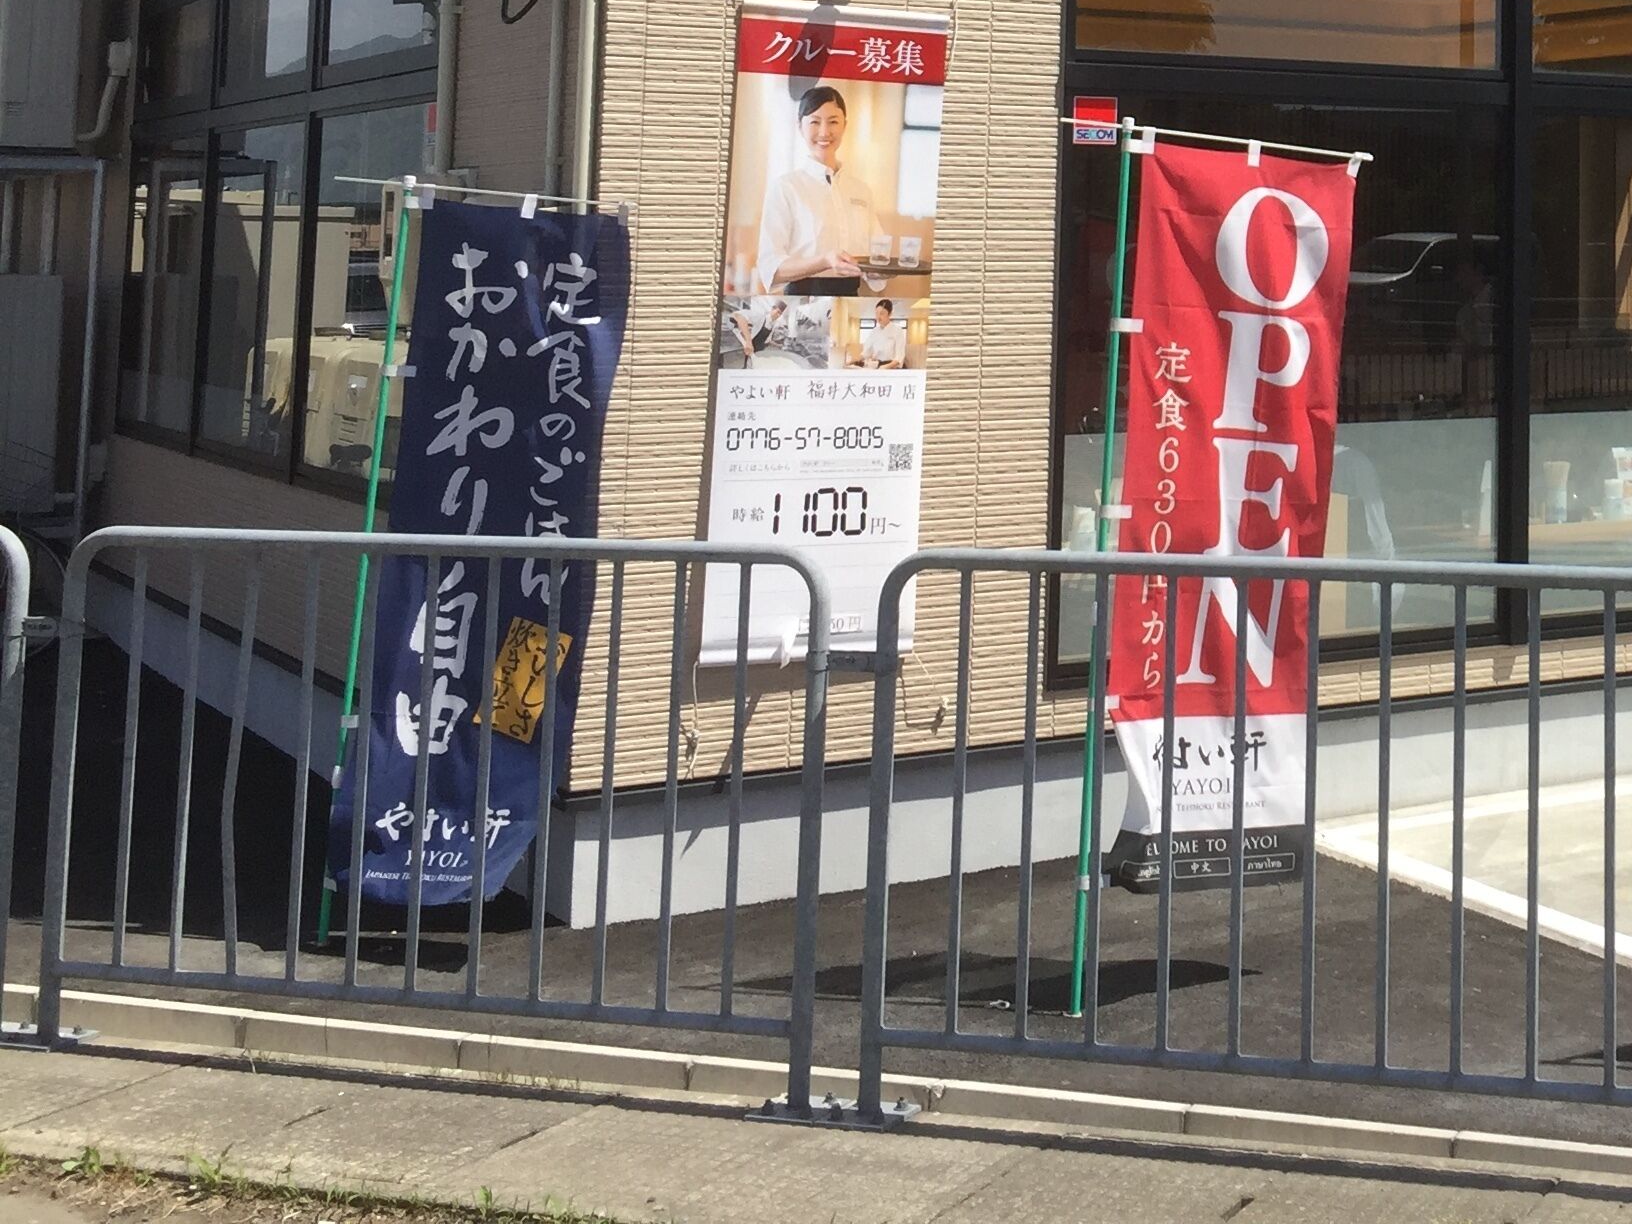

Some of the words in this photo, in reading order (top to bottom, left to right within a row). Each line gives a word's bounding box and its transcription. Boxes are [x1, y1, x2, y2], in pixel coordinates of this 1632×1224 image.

[762, 31, 924, 76] クルー募集
[1076, 129, 1114, 140] SECOM
[730, 384, 791, 401] やよい軒
[903, 384, 917, 400] 店
[726, 426, 884, 451] 0776-57-8005
[1176, 187, 1329, 689] OPEN
[1172, 778, 1231, 796] YAYOI
[1206, 838, 1227, 852] TO
[1243, 835, 1278, 850] AYOI
[405, 849, 463, 868] YYOI
